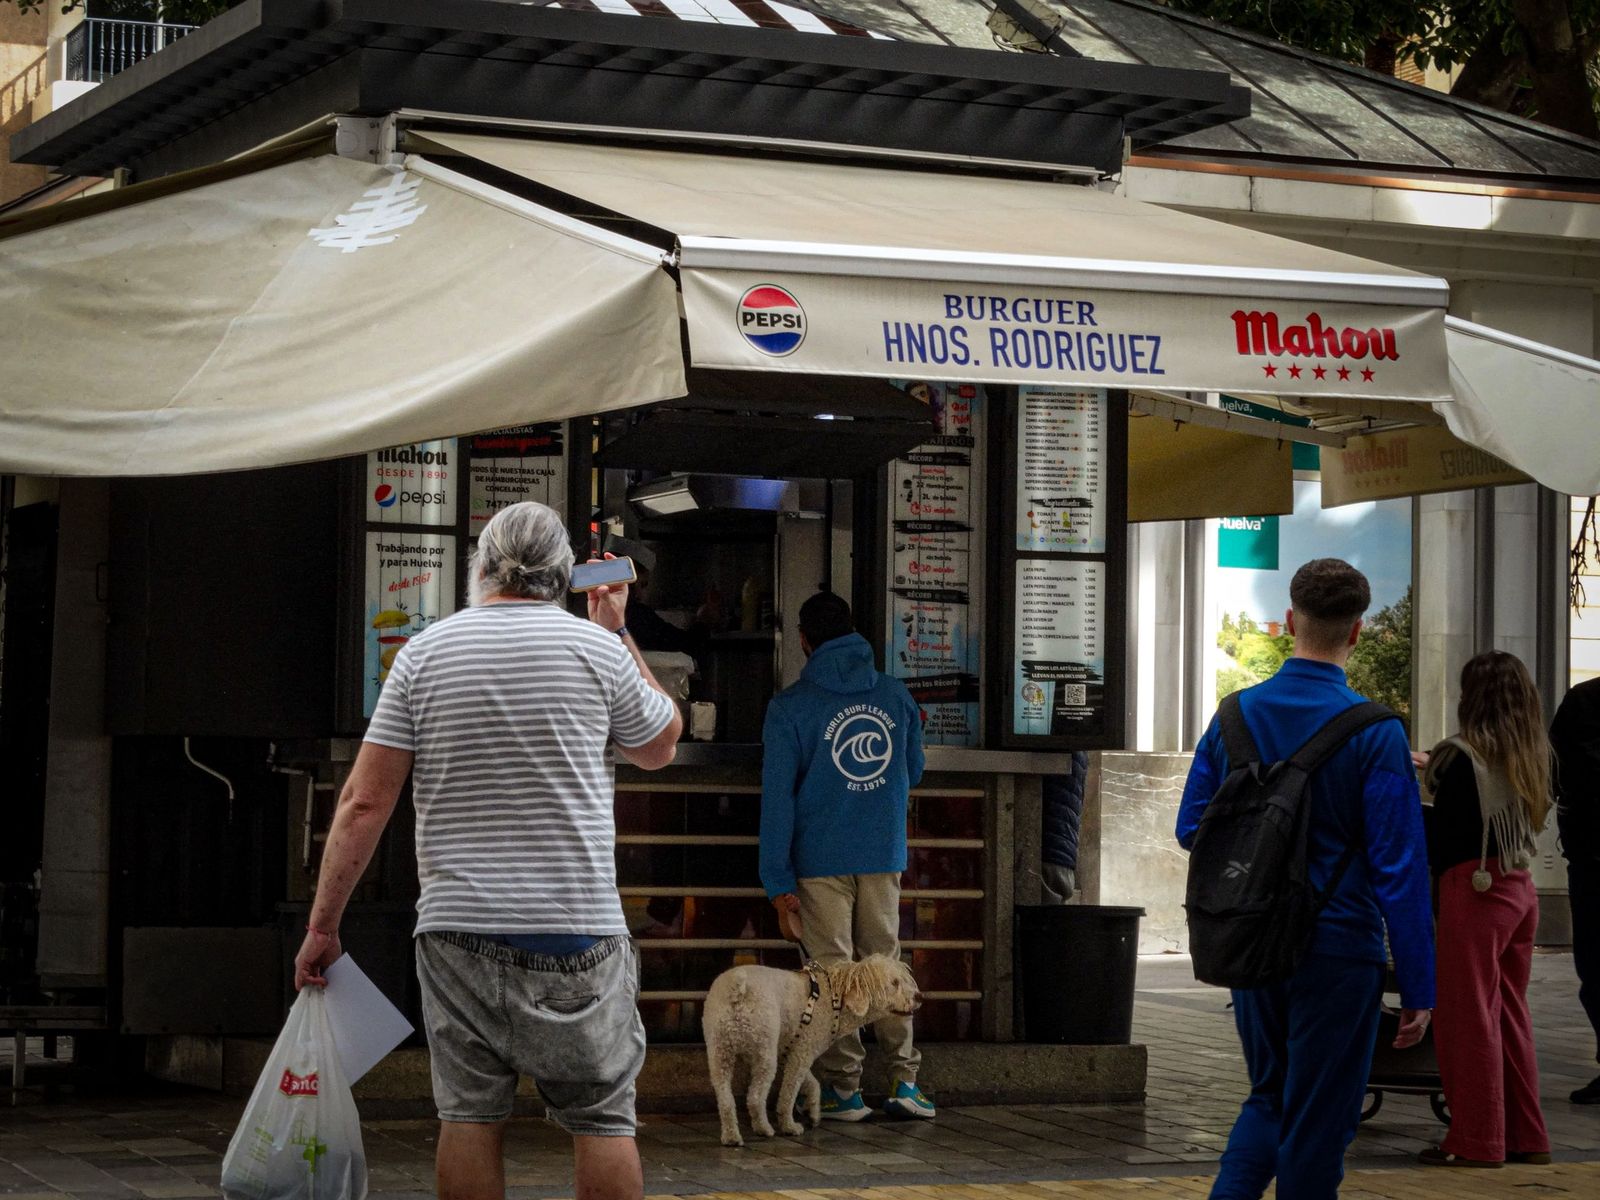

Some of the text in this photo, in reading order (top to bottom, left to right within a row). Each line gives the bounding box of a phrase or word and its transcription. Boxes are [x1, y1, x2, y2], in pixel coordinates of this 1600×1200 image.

[943, 294, 1098, 326] BURGUER
[742, 311, 802, 329] PEPSI
[1231, 310, 1400, 361] Mahou
[882, 321, 1166, 375] HNOS. RODRIGUEZ
[1221, 400, 1253, 413] uelva,
[376, 468, 448, 480] DESDE 1890
[500, 467, 535, 475] NUESTRAS
[536, 468, 556, 477] CAJAS
[475, 475, 540, 485] DE HAMBURGUESAS
[485, 485, 530, 493] CONGELADAS
[400, 490, 447, 507] pepsi
[376, 543, 446, 556] Trabajando por
[379, 558, 443, 569] y para Huelva
[388, 572, 431, 592] desde 1967
[823, 704, 896, 741] WORLD SURF LEAGUE
[847, 781, 862, 792] EST.
